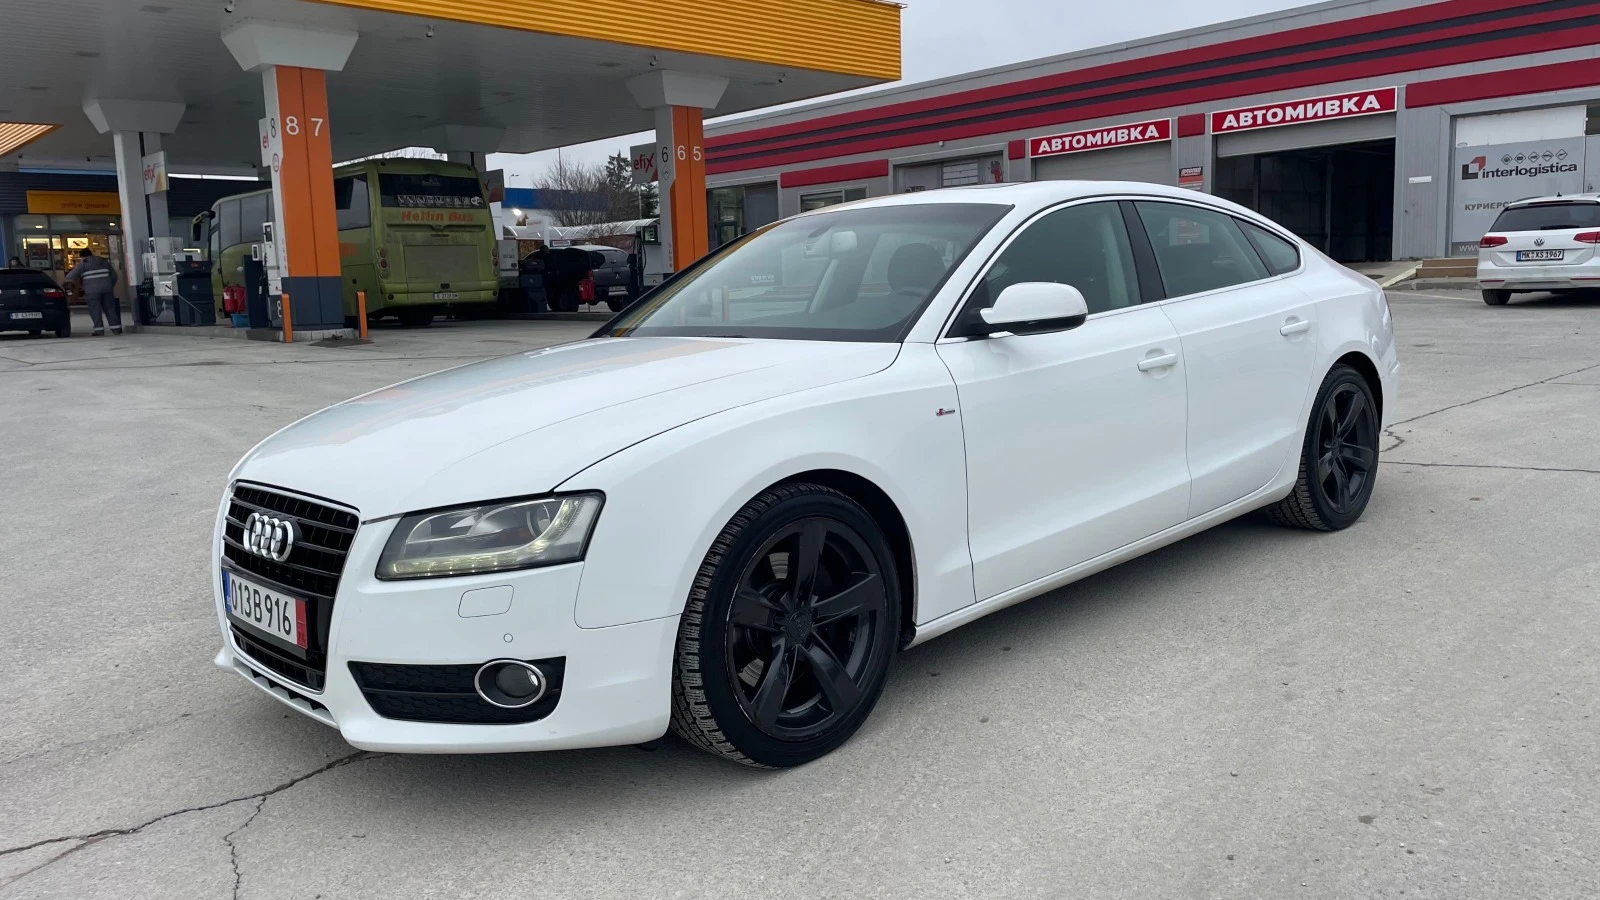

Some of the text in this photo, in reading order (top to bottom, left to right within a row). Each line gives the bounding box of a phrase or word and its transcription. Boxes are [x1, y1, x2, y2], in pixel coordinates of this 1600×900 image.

[1221, 94, 1381, 129] АВТОМИВКА
[270, 117, 277, 138] 8
[286, 115, 299, 135] 8
[310, 117, 324, 137] 7
[1038, 124, 1160, 154] АВТОМИВКА
[661, 146, 669, 163] 6
[677, 144, 686, 161] 6
[693, 146, 702, 161] 5
[633, 152, 655, 174] efix
[1482, 161, 1578, 178] interlogistica
[231, 579, 292, 636] 013B916
